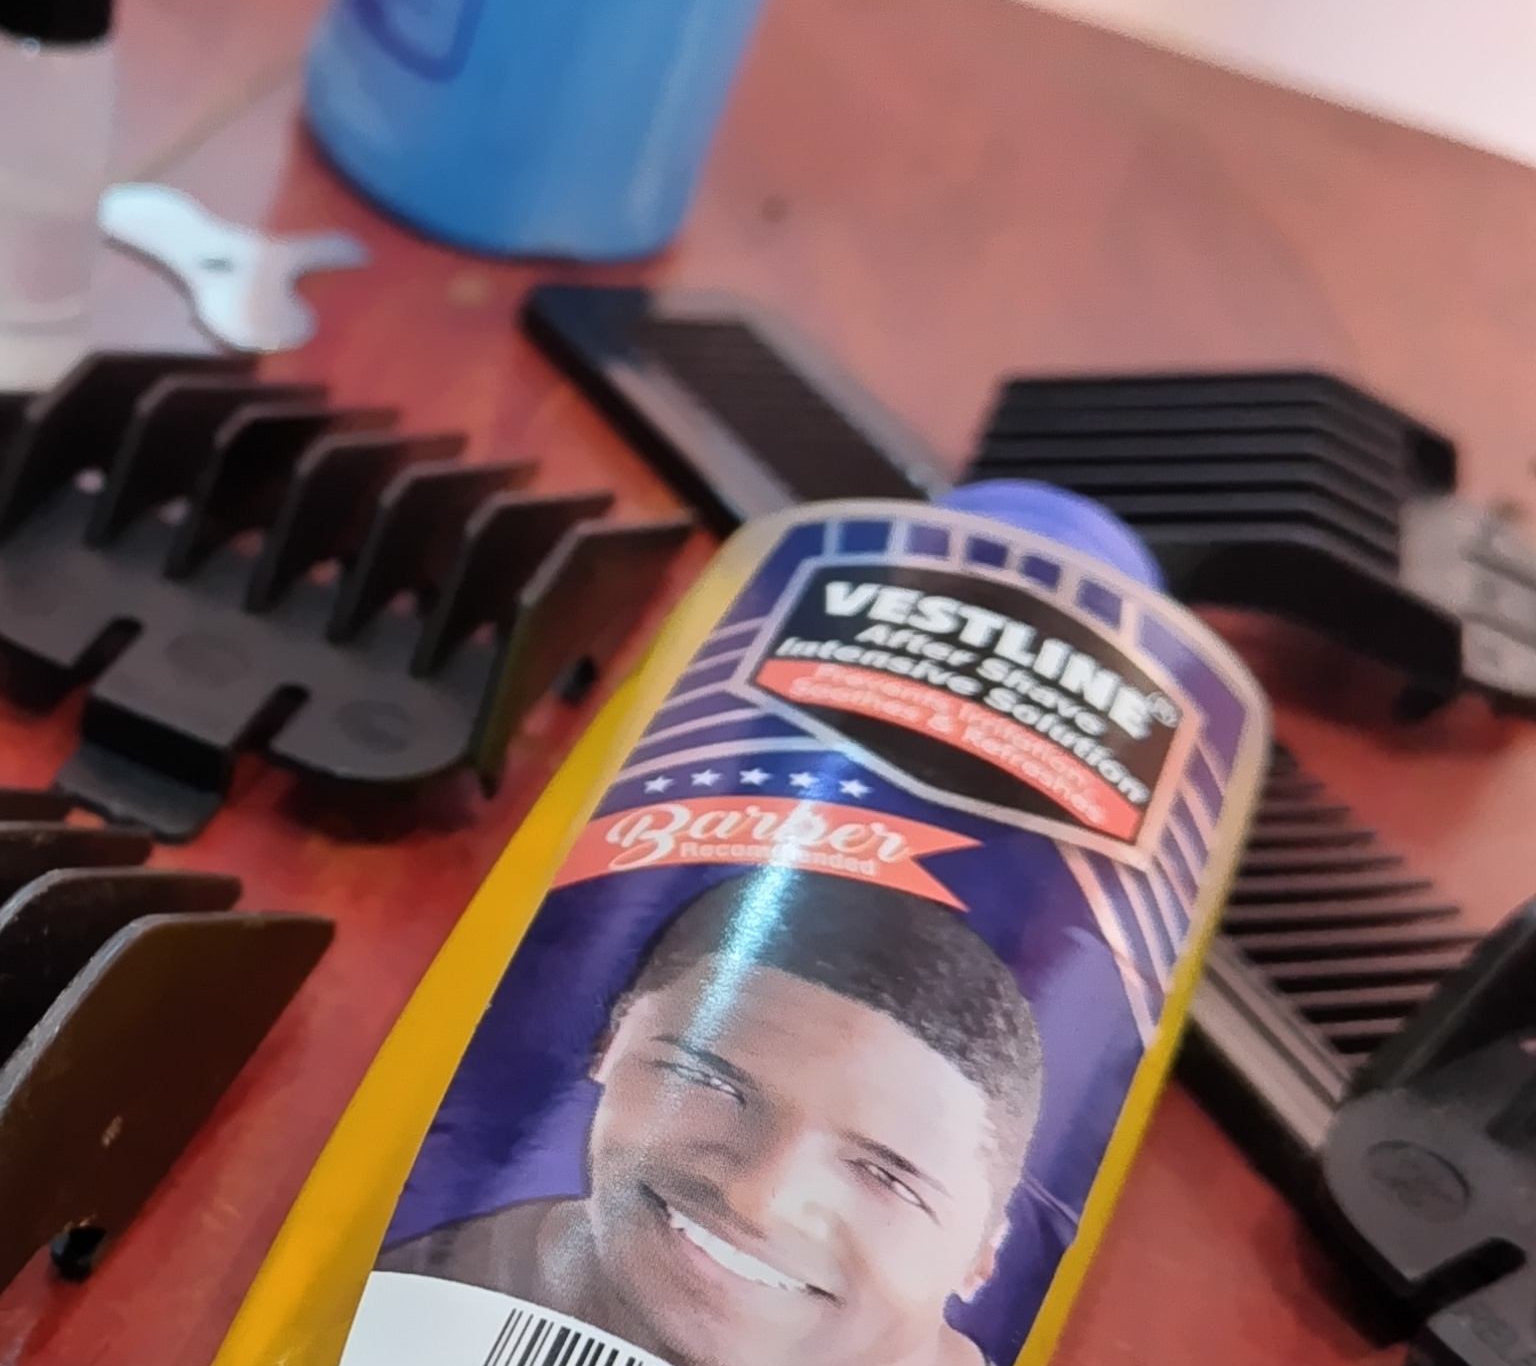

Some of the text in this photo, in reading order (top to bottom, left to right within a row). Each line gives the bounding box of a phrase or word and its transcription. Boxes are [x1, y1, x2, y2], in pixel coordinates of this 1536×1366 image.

[775, 637, 1150, 803] Intensive Solution
[855, 624, 1107, 735] After Shave
[605, 799, 912, 871] Barber
